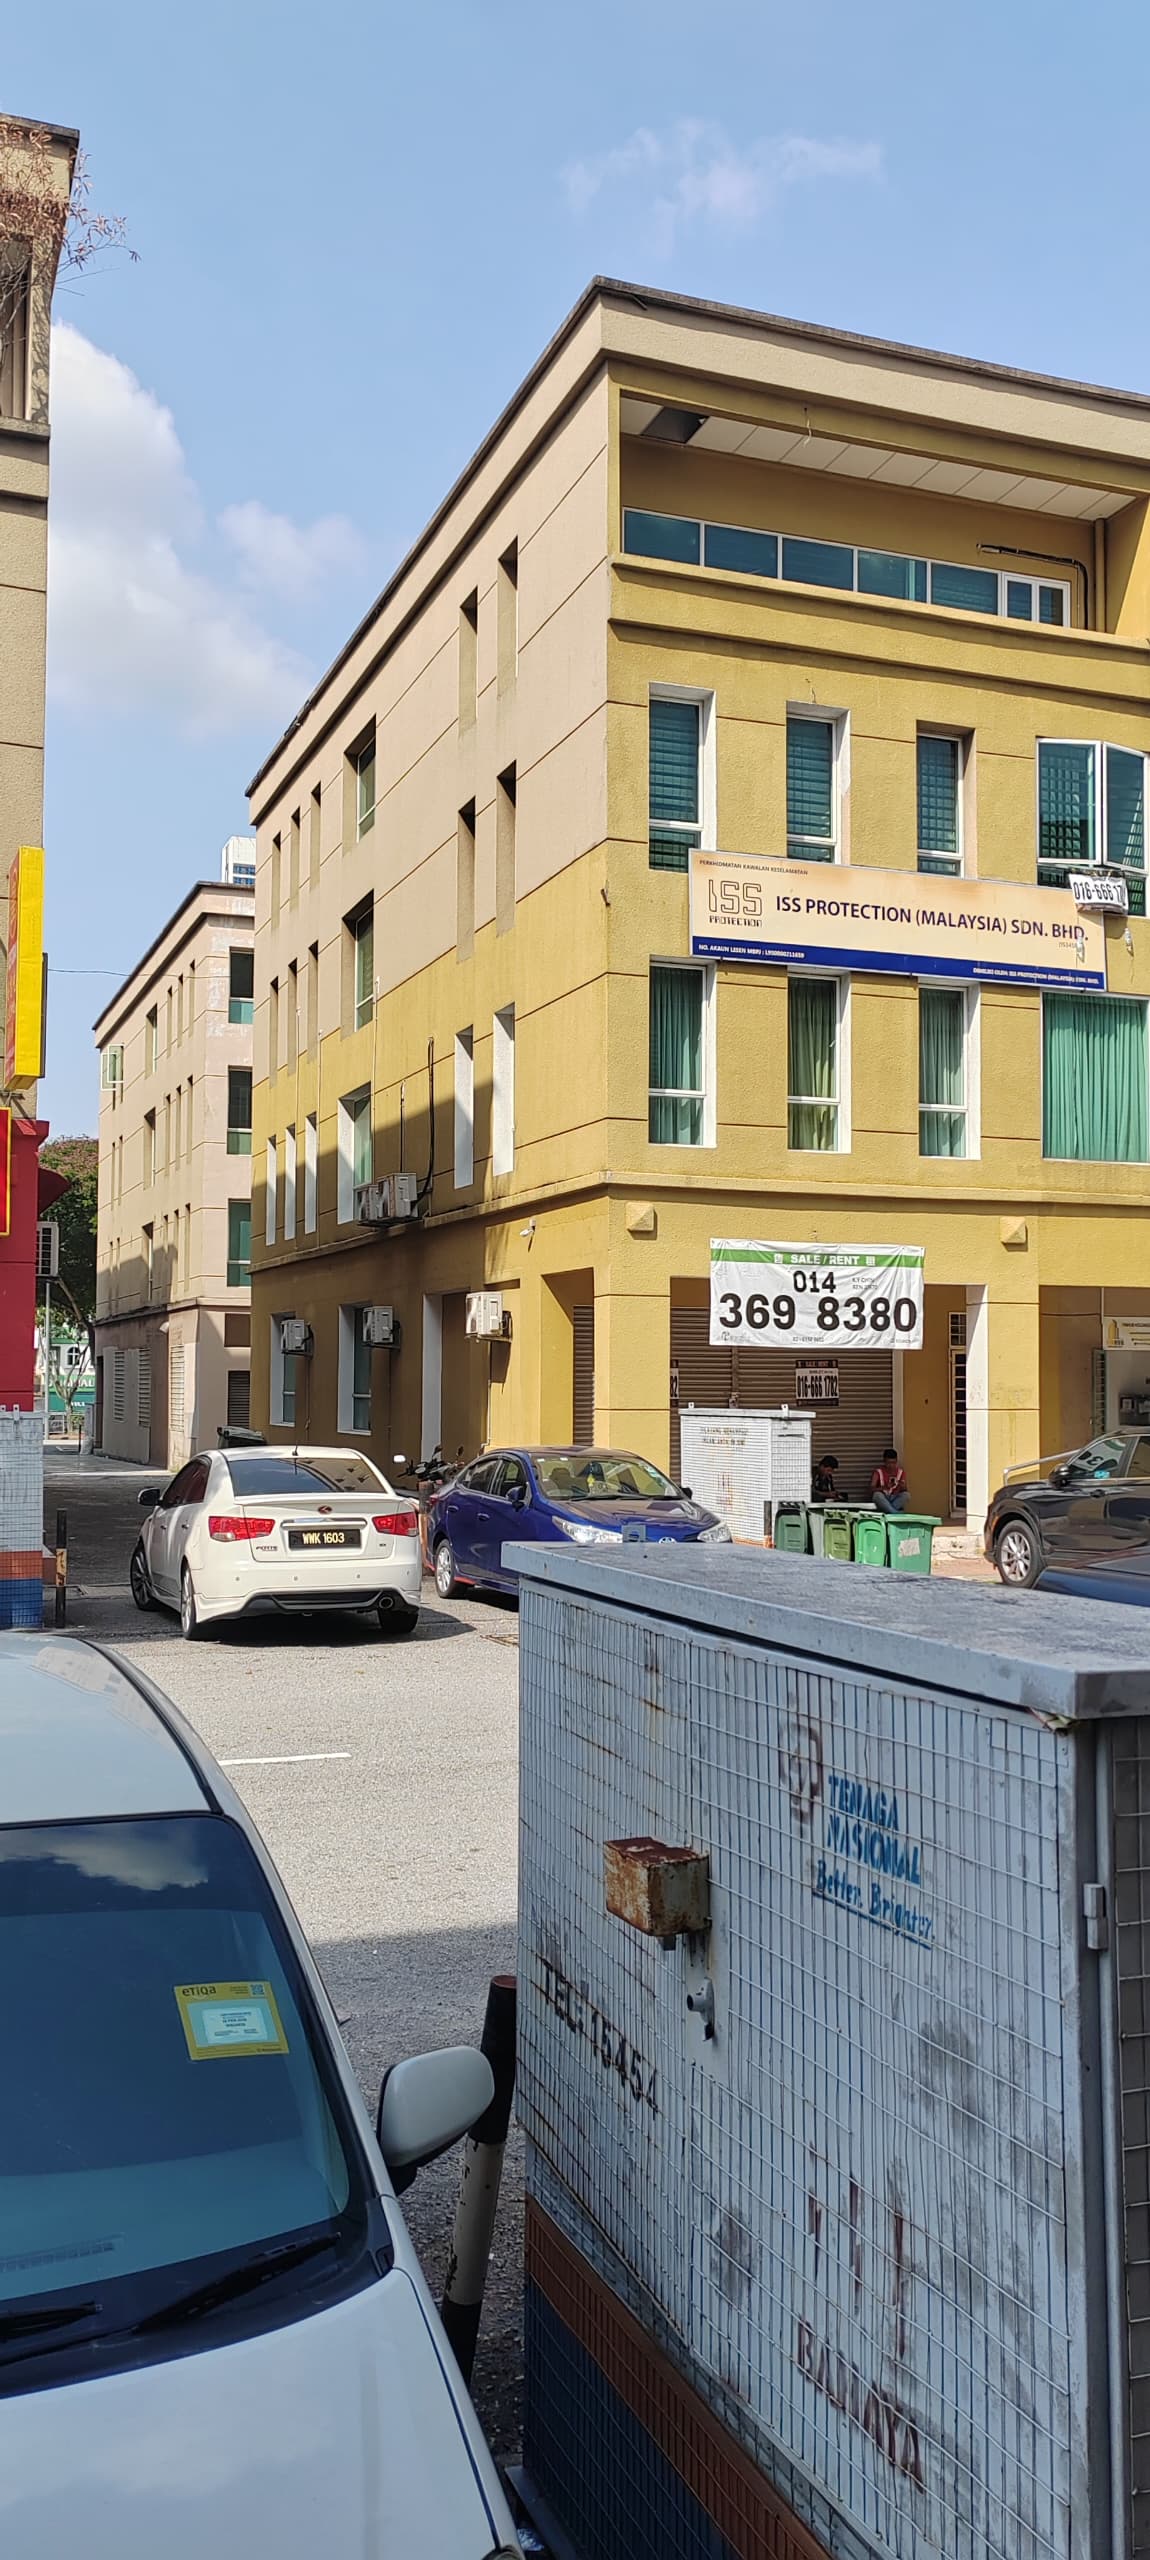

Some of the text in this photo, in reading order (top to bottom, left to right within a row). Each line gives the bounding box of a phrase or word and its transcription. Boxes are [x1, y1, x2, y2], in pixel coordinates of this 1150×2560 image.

[743, 863, 770, 872] KAWALAN
[708, 879, 762, 916] ISS
[776, 895, 1089, 941] ISS PROTECTION (MALAYSIA) SDN. BHD.
[790, 1254, 820, 1265] SALE
[830, 1255, 861, 1266] RENT
[793, 1270, 837, 1293] 014
[719, 1293, 917, 1332] 369 8380
[797, 1375, 823, 1398] 016-666
[302, 1532, 345, 1544] WWK 1603
[828, 1774, 899, 1832] TENAGA
[827, 1813, 922, 1886] NASIONAL
